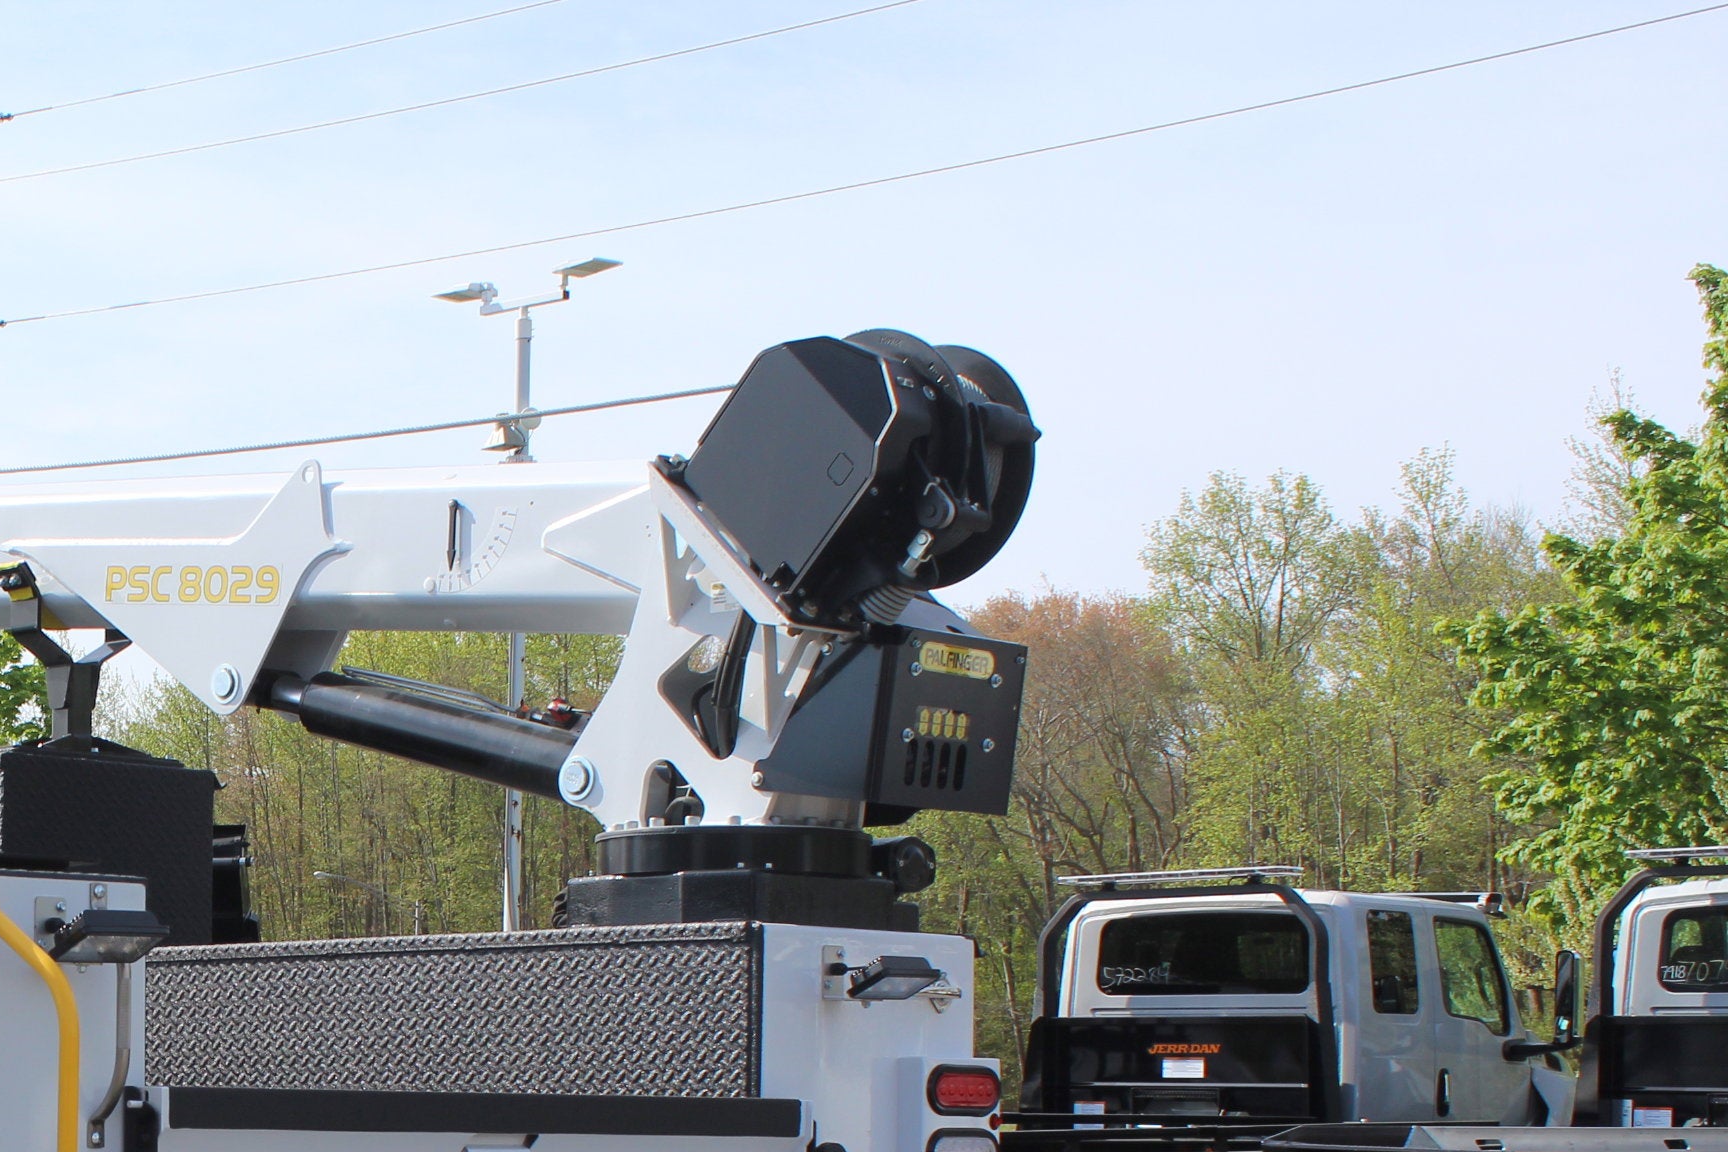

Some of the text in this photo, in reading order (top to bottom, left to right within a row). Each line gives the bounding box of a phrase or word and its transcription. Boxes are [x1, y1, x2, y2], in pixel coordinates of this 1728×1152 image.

[105, 564, 280, 604] PSC 8029
[924, 647, 989, 676] PALFINGER
